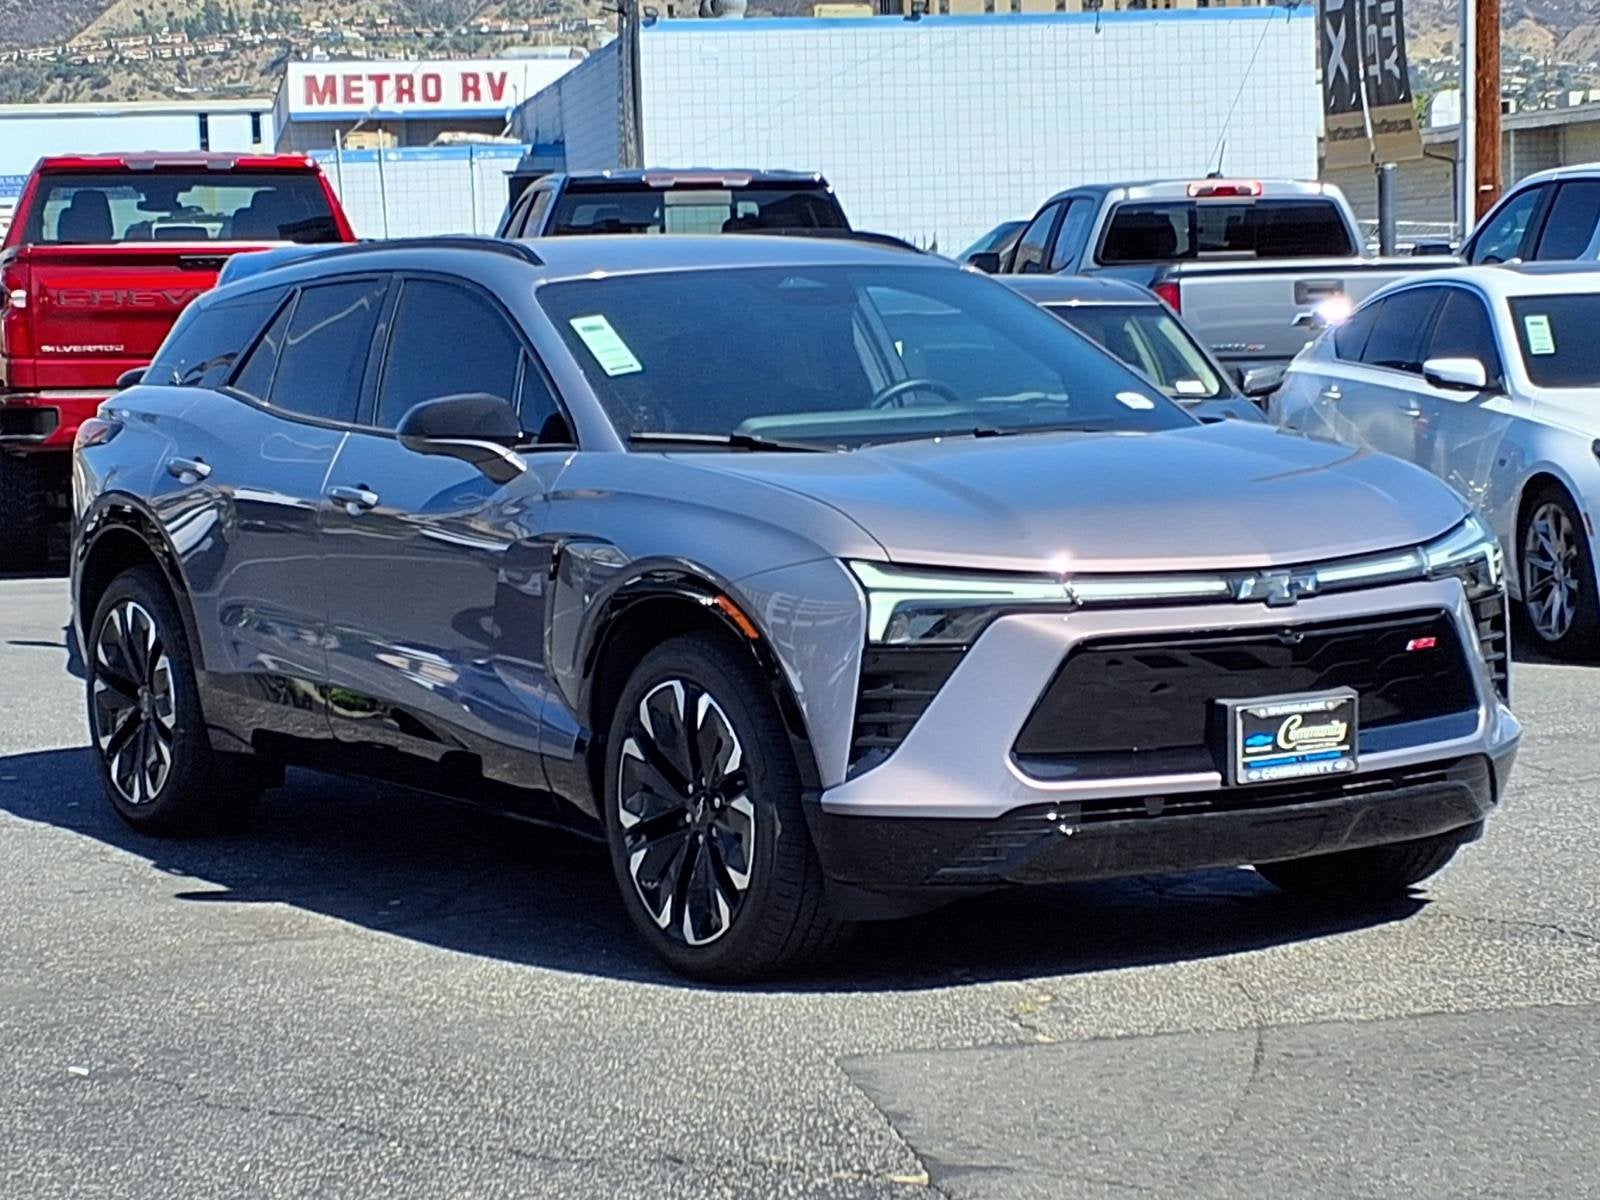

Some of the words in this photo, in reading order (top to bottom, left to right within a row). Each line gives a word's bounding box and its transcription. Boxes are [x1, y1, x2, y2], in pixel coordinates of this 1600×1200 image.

[303, 73, 442, 106] METRO
[459, 71, 508, 103] RV
[53, 290, 200, 307] CHEV
